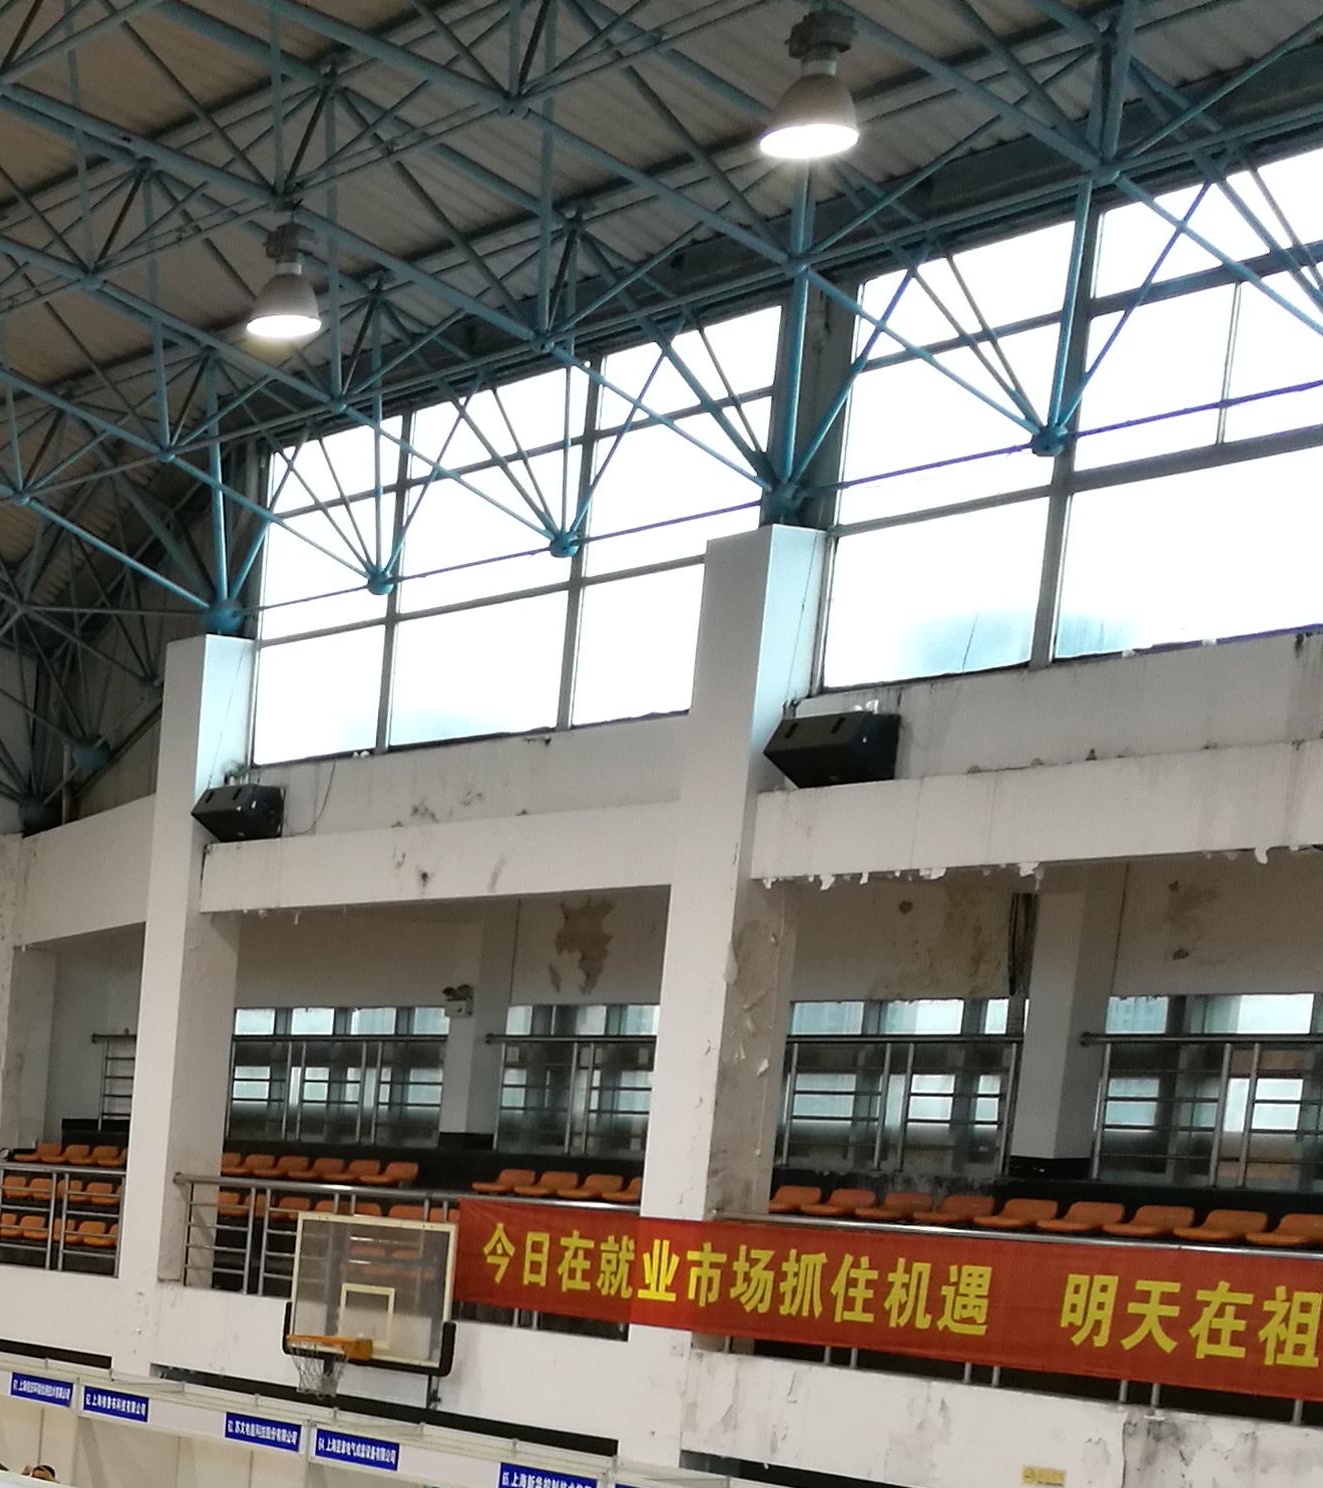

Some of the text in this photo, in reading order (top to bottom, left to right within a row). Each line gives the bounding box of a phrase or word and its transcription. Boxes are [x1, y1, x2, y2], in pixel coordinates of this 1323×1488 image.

[482, 1223, 1320, 1368] 今日在就业市场抓住机遇 明天在祖
